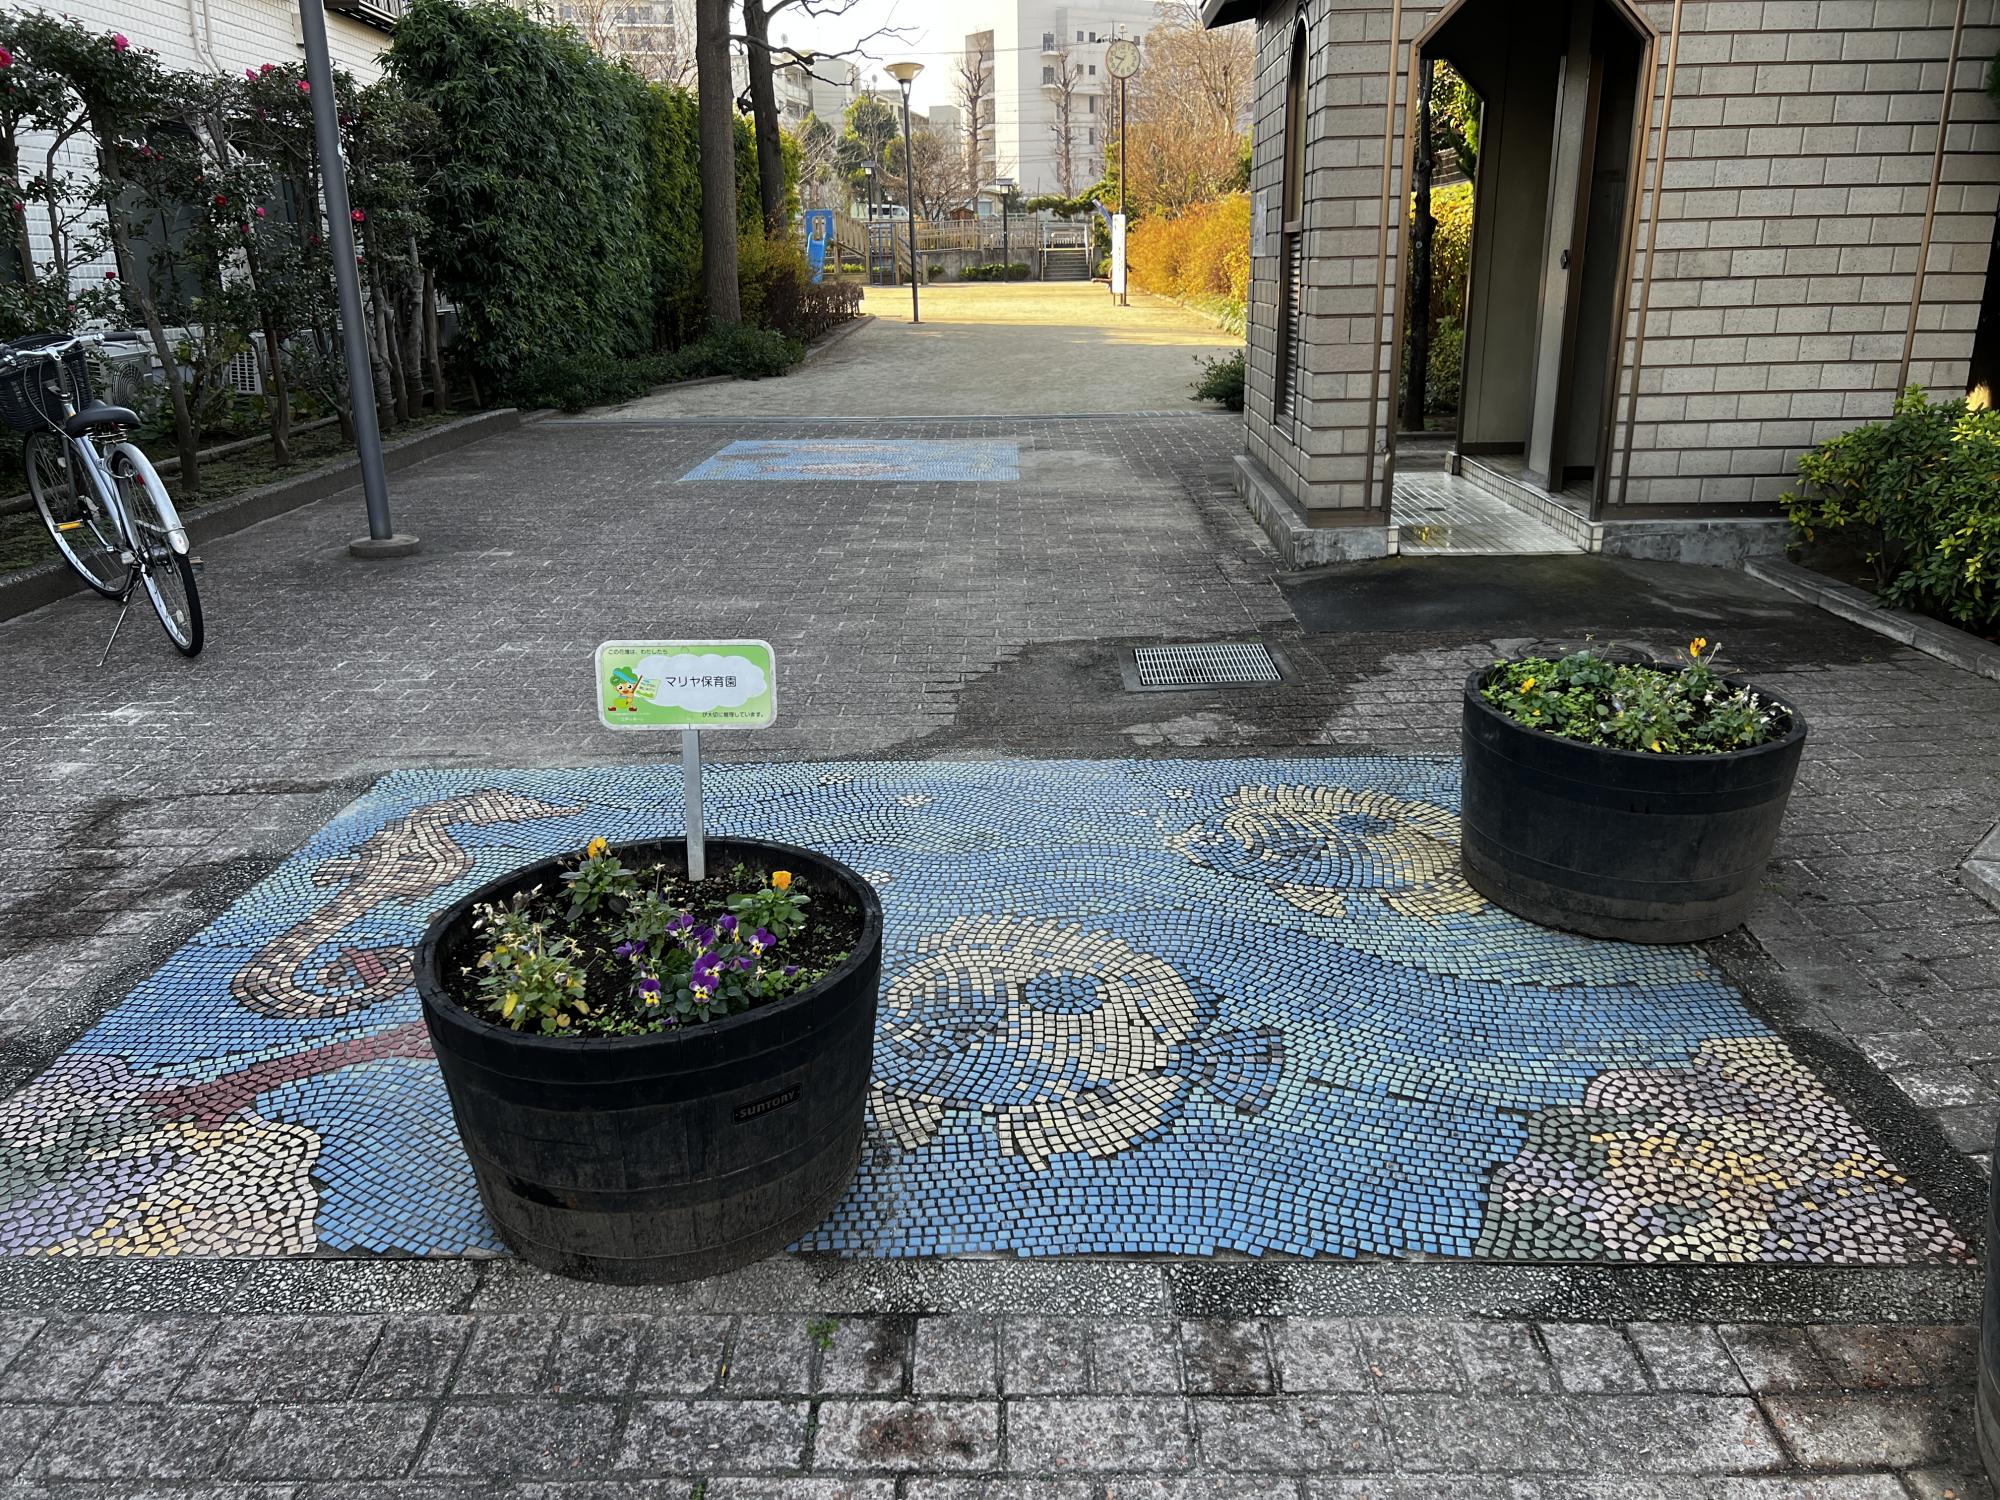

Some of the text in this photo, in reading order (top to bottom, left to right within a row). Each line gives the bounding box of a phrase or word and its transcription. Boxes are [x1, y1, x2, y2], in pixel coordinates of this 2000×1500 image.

[665, 675, 737, 688] マリヤ保育園
